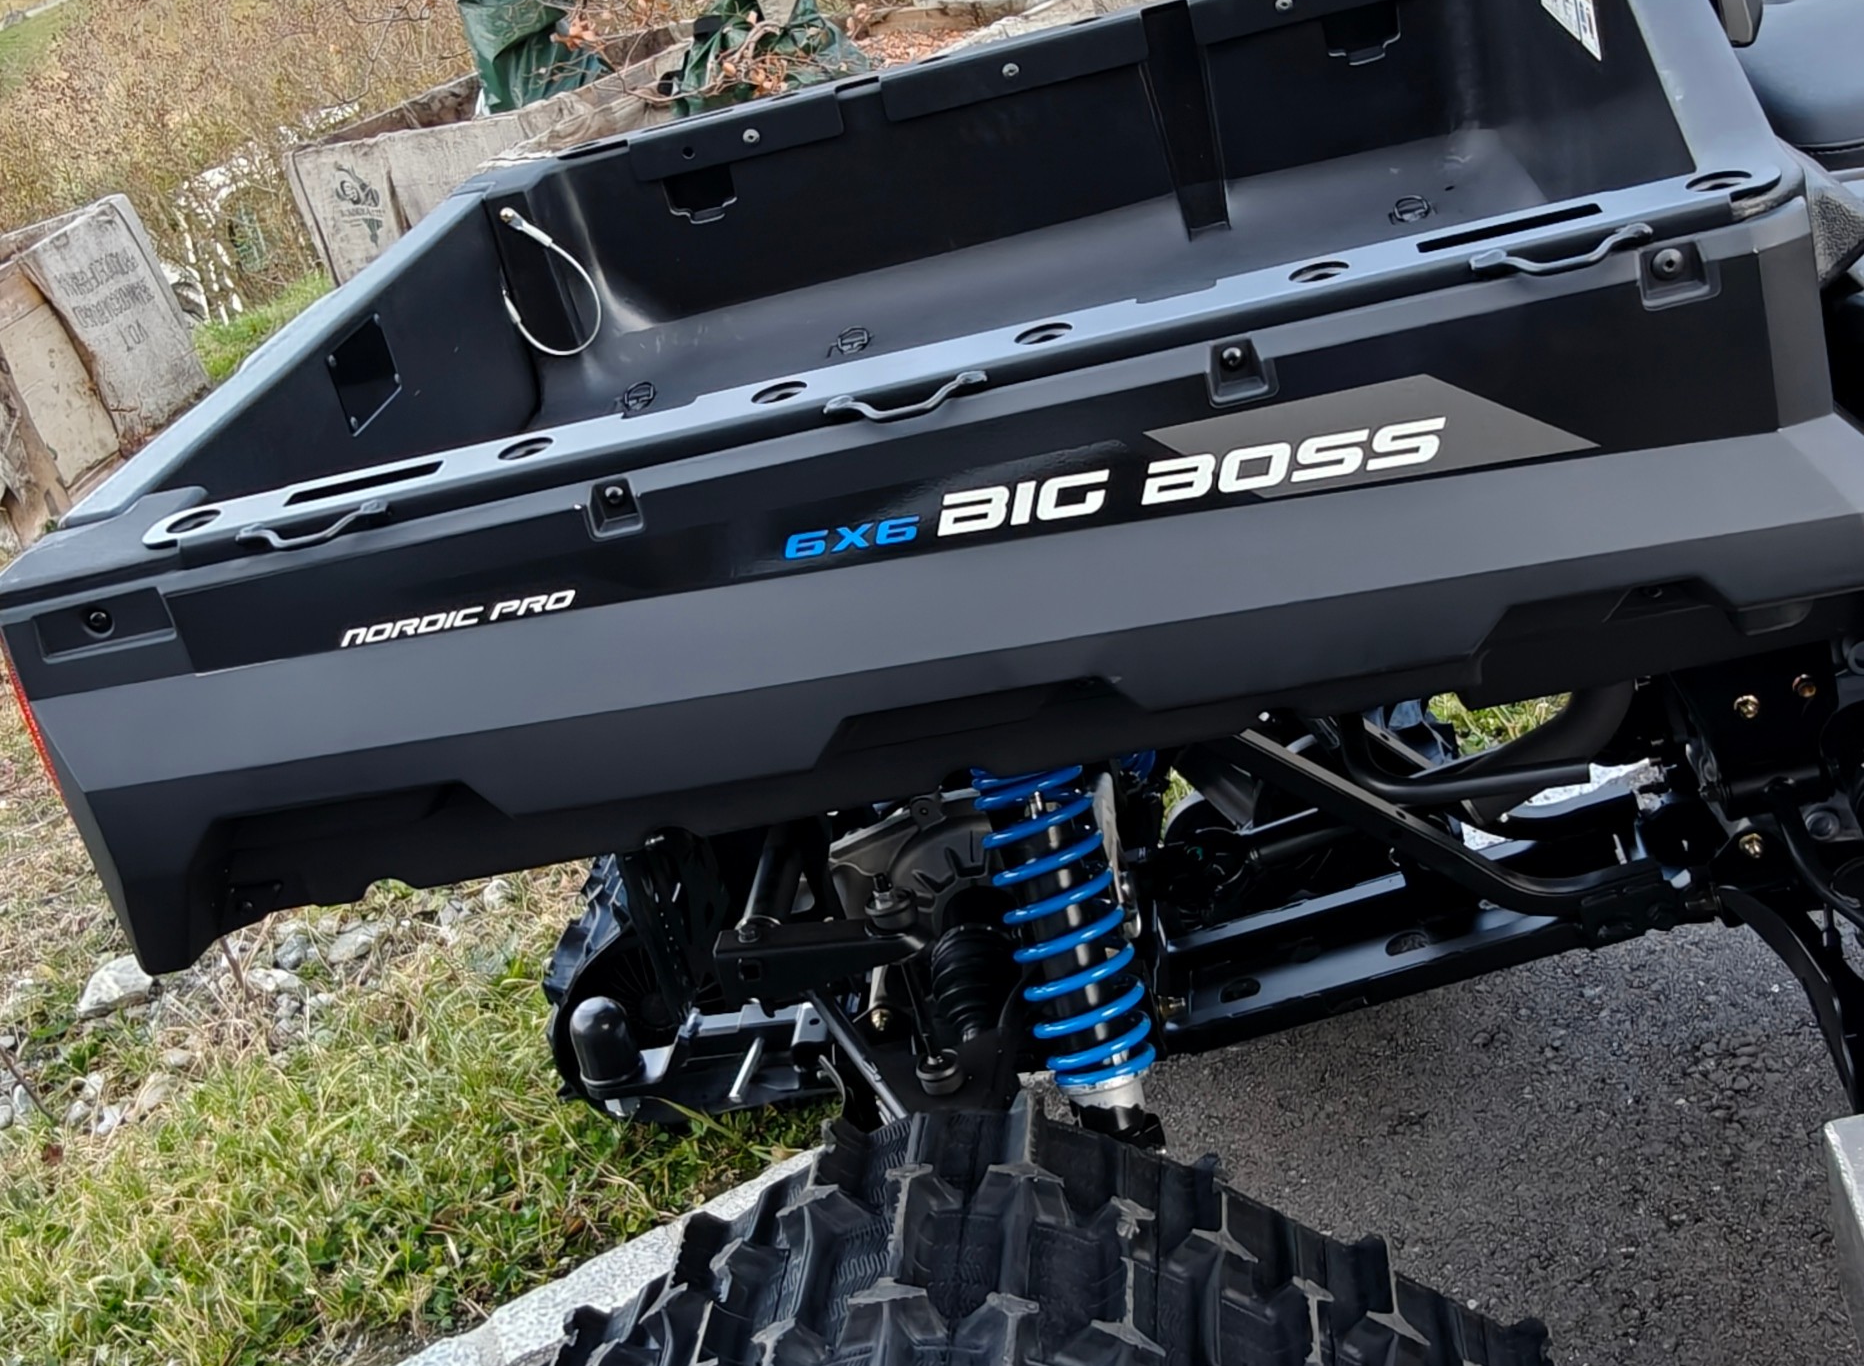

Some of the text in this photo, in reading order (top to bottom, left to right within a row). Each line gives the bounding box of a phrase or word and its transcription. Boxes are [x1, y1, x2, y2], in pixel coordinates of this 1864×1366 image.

[785, 416, 1447, 560] 6X6 BIG BOSS
[340, 589, 576, 648] NORDIC PRO
